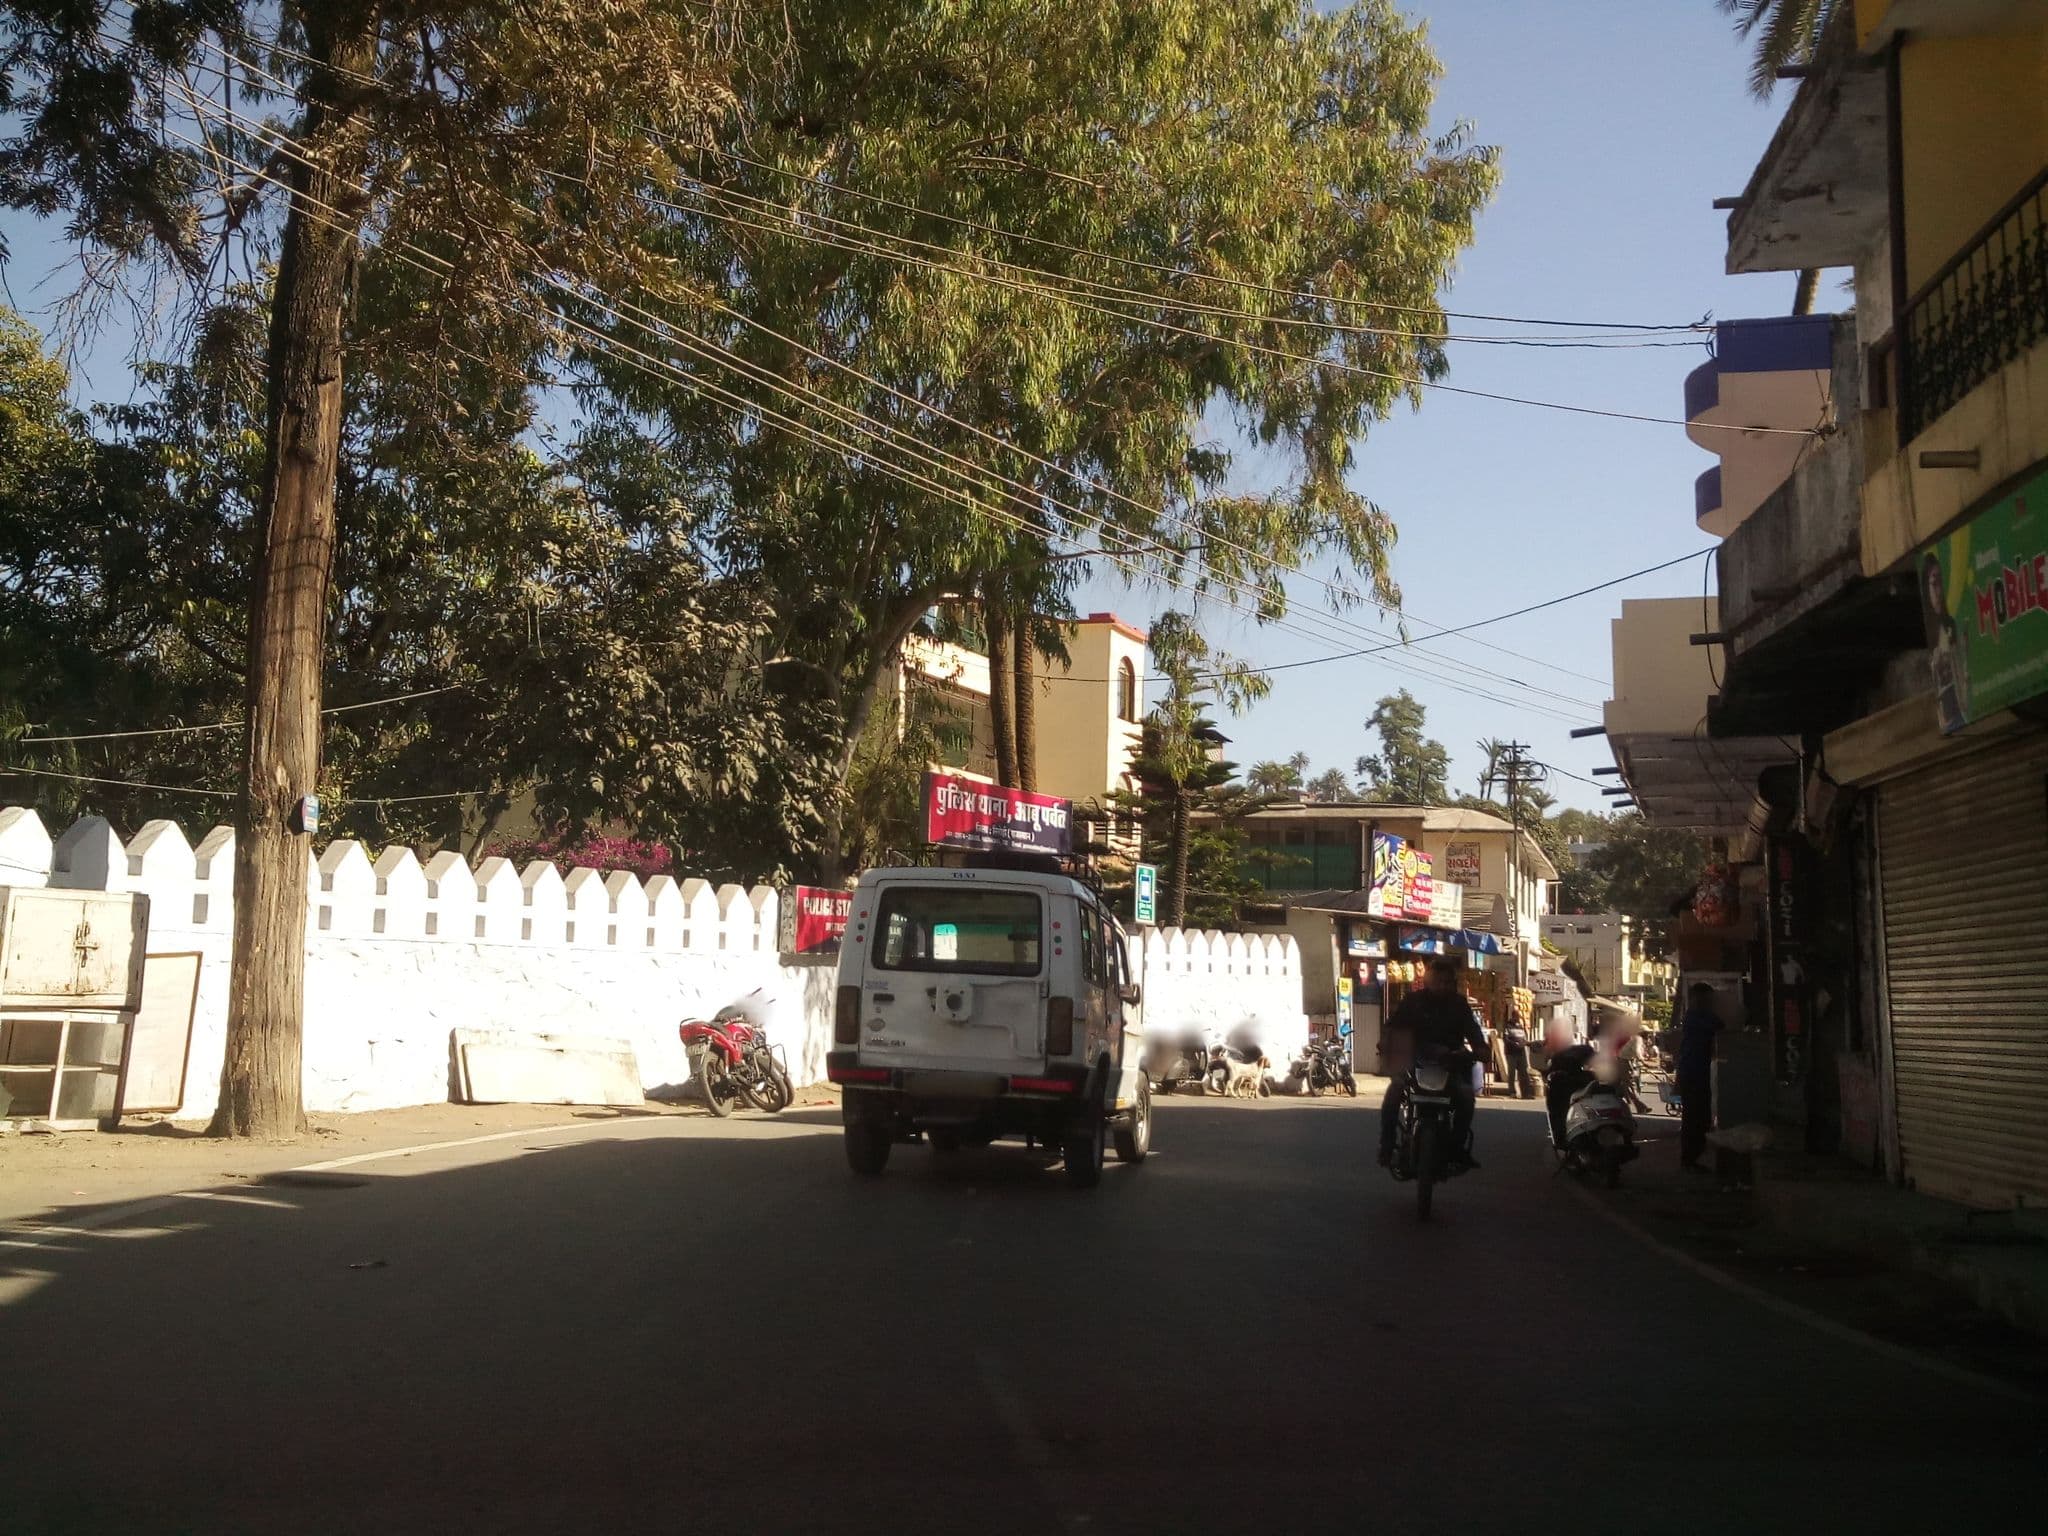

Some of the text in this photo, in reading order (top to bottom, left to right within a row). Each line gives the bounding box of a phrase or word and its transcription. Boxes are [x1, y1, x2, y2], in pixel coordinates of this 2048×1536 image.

[936, 782, 975, 815] पुलिस
[1014, 800, 1042, 832] आबू
[1041, 802, 1067, 829] पर्वत
[803, 896, 834, 916] POLICE
